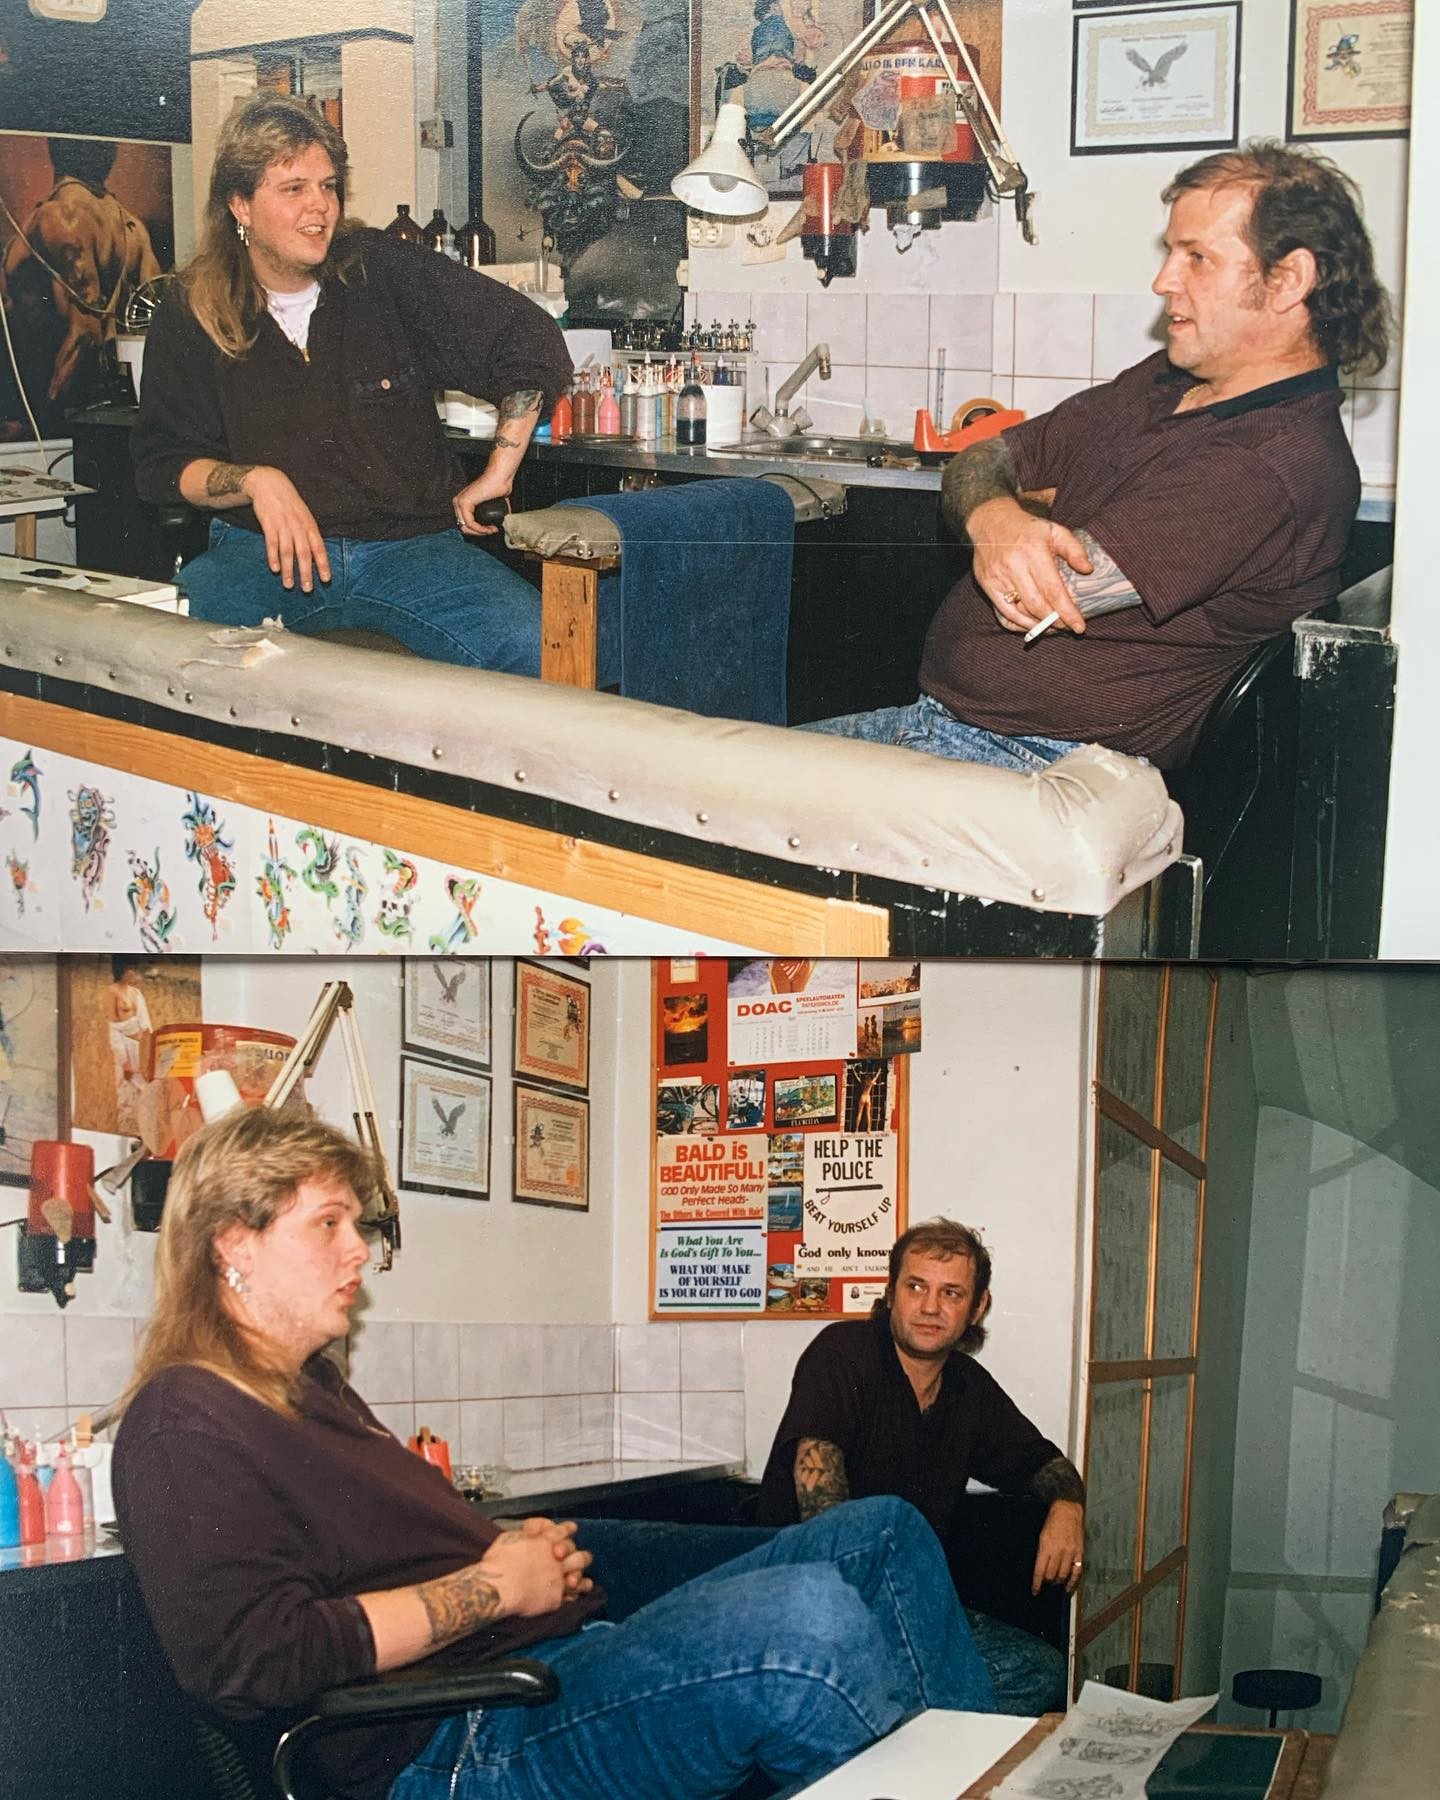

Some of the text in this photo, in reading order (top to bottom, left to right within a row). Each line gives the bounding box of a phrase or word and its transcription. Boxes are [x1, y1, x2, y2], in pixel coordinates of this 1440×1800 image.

[737, 1001, 793, 1017] DOAC
[676, 1143, 726, 1162] BALD
[814, 1138, 883, 1158] HELP THE
[660, 1161, 764, 1182] BEAUTIFUL!
[822, 1161, 873, 1181] POLICE
[680, 1185, 699, 1195] Only
[701, 1184, 726, 1194] Made
[728, 1183, 738, 1193] So
[740, 1183, 764, 1193] Many
[681, 1196, 716, 1206] Perfect
[660, 1210, 671, 1218] The
[732, 1207, 746, 1216] With
[804, 1199, 826, 1224] BEAT
[828, 1211, 879, 1234] YOURSELF
[878, 1196, 892, 1213] UP
[677, 1235, 744, 1246] What You Are
[660, 1248, 668, 1258] Is
[671, 1247, 697, 1258] God's
[699, 1247, 719, 1260] Gift
[721, 1247, 733, 1257] To
[798, 1247, 821, 1258] God
[827, 1246, 851, 1259] only
[670, 1264, 751, 1274] WHAT YOU MAKE
[678, 1276, 743, 1286] OF YOURSELF
[659, 1288, 762, 1298] IS YOUR GIFT TO GOD
